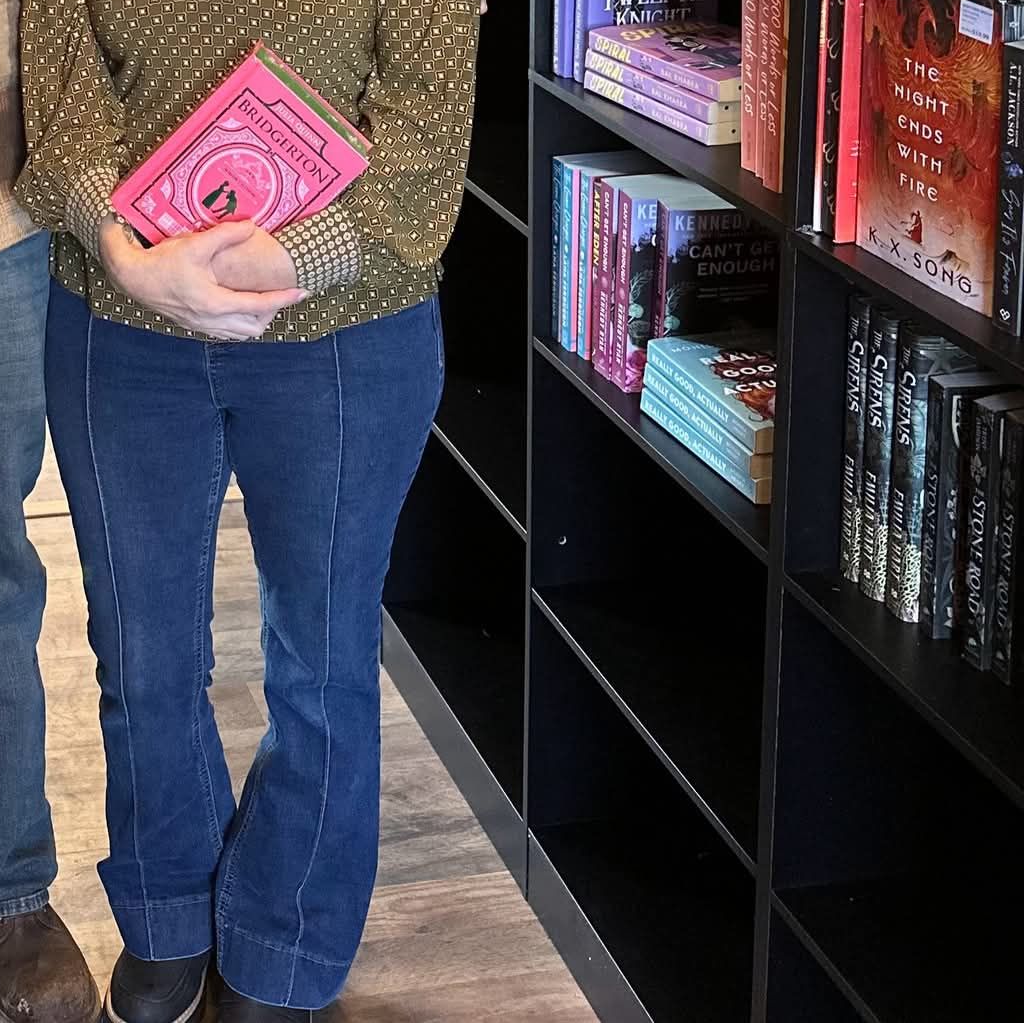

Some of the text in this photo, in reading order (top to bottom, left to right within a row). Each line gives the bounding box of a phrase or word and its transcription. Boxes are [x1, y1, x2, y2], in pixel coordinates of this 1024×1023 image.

[594, 36, 633, 64] SPIRAL
[743, 17, 757, 61] Words
[769, 32, 783, 79] Words
[589, 53, 625, 83] SPIRAL
[904, 57, 940, 82] THE
[589, 75, 626, 104] SPIRAL
[742, 83, 754, 118] Less
[894, 82, 950, 117] NIGHT
[767, 100, 779, 136] Less
[897, 116, 945, 145] ENDS
[1006, 89, 1017, 146] JACKSON
[237, 98, 330, 184] BRIDGERTON
[896, 141, 943, 175] WITH
[602, 191, 610, 217] CAN'T
[899, 172, 939, 202] FIRE
[592, 191, 602, 266] AFTER EDEN
[601, 218, 609, 237] GET
[620, 202, 629, 227] CAN'T
[620, 228, 628, 246] GET
[688, 242, 745, 260] CAN'T
[600, 238, 609, 273] ENOUGH
[619, 247, 627, 284] ENOUGH
[696, 257, 775, 277] ENOUGH
[869, 226, 974, 296] K. X. SONG
[651, 352, 729, 424] REALLY GOOD, ACTUALLY
[722, 363, 776, 378] GOO
[845, 339, 865, 414] SIRENS
[647, 374, 669, 401] REALLY
[669, 392, 691, 419] GOOD,
[691, 412, 723, 444] ACTUALLY
[867, 353, 888, 429] SIRENS
[896, 369, 916, 446] SIRENS
[644, 399, 727, 473] REALLY GOOD, ACTUALLY
[842, 454, 855, 546] EMILIA HART
[863, 470, 876, 566] EMILIA HART
[890, 486, 905, 581] EMILIA HART
[966, 495, 987, 616] STONE ROAD
[996, 510, 1016, 630] STONE ROAD
